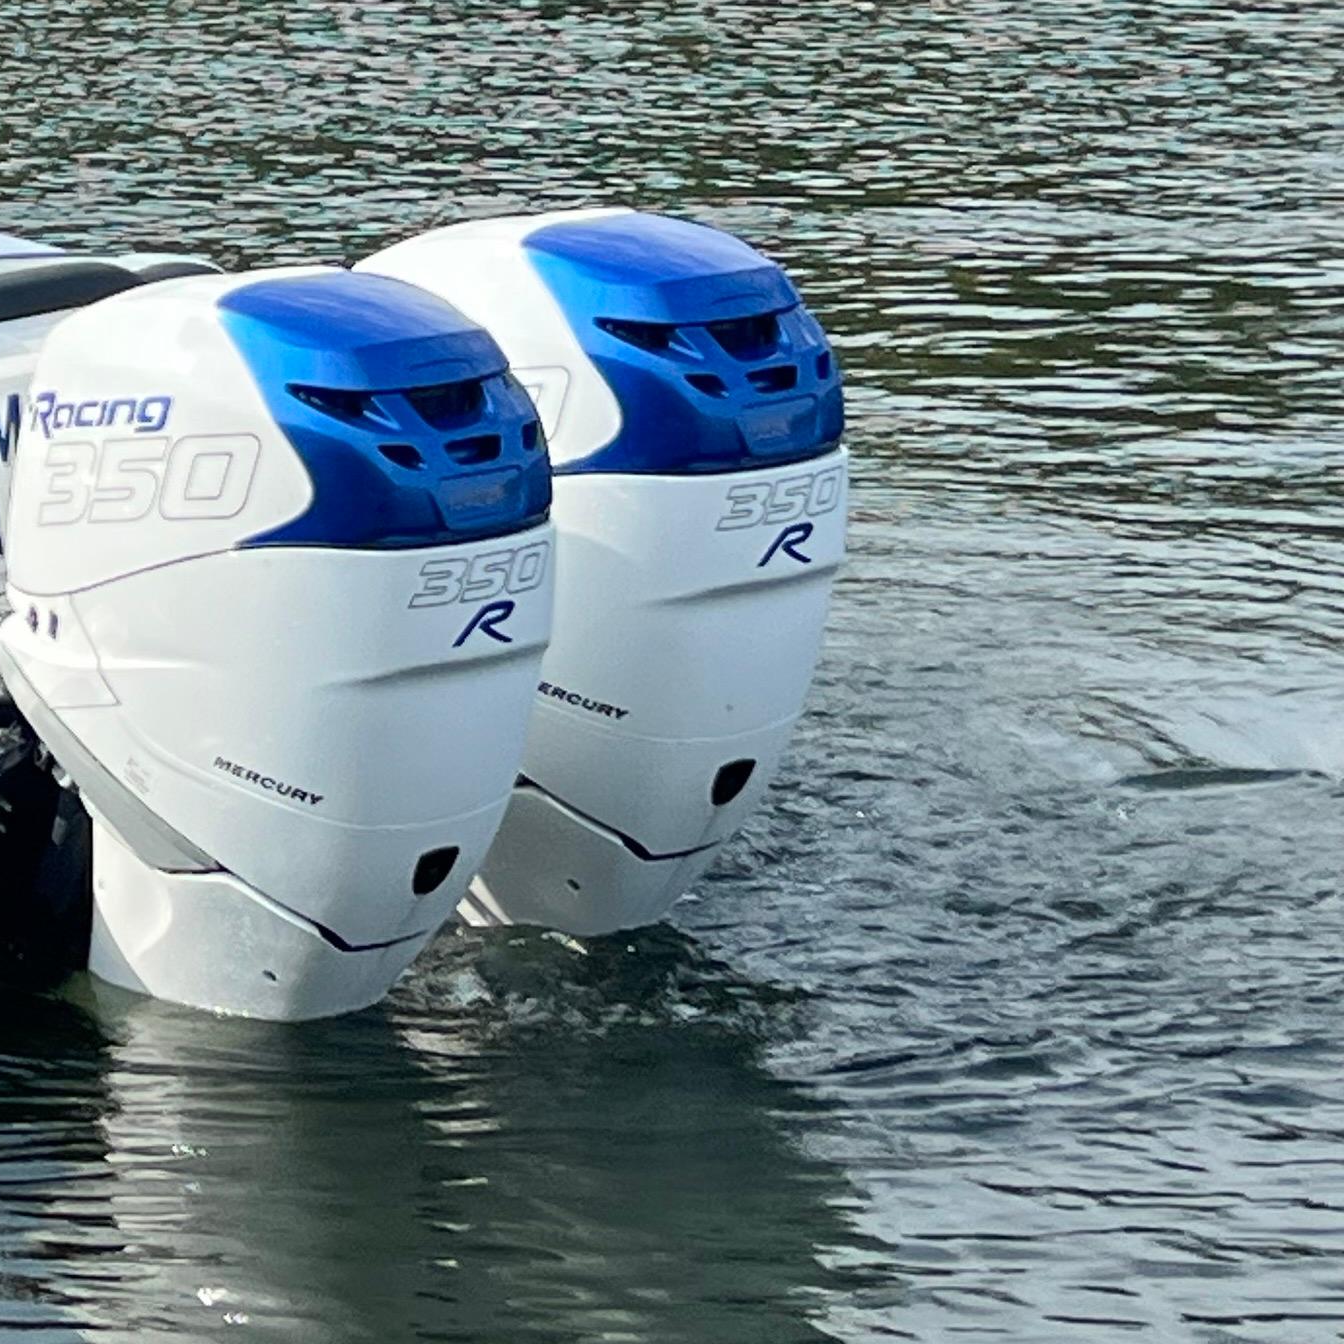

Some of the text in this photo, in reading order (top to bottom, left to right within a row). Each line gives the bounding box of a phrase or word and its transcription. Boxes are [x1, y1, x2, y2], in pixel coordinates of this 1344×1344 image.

[30, 391, 172, 439] Racing
[37, 433, 262, 528] 350
[714, 465, 845, 532] 350
[757, 522, 813, 567] R
[408, 540, 550, 610] 350
[452, 600, 516, 648] R
[537, 680, 629, 720] ERCURY
[213, 756, 324, 805] MERCURY
